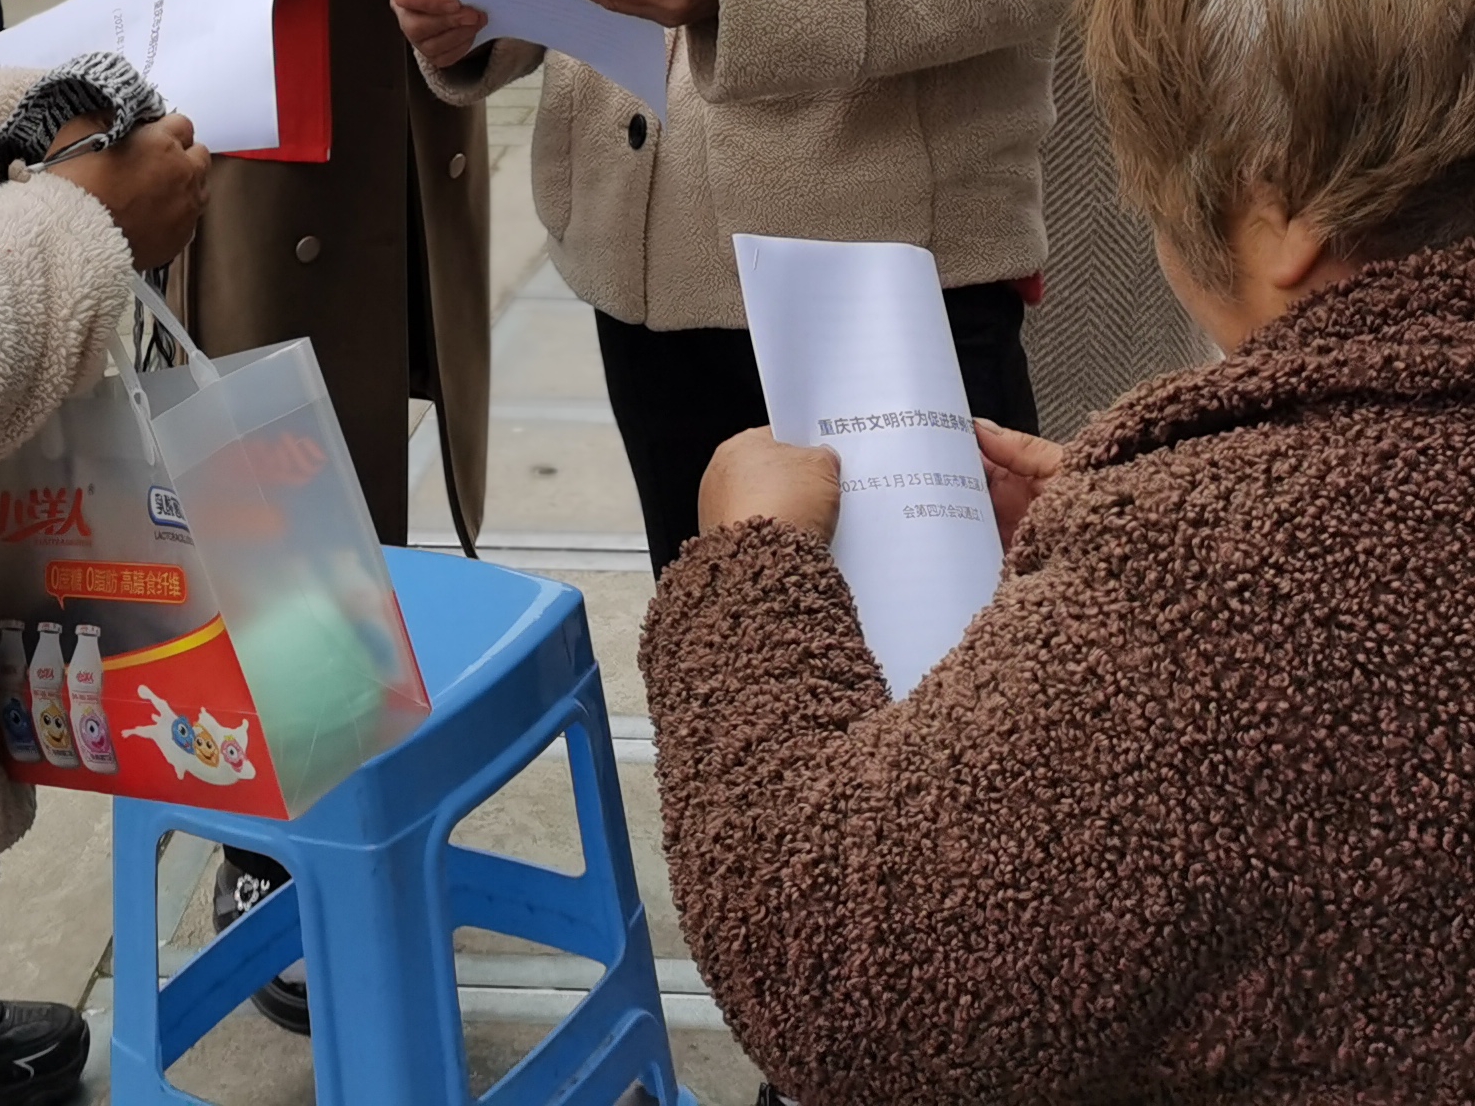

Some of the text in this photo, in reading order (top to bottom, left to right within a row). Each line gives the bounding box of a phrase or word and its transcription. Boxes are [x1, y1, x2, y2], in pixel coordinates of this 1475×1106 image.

[112, 7, 125, 56] (2021年1
[85, 566, 118, 594] 0脂肪
[120, 569, 181, 597] 高膳食纤维
